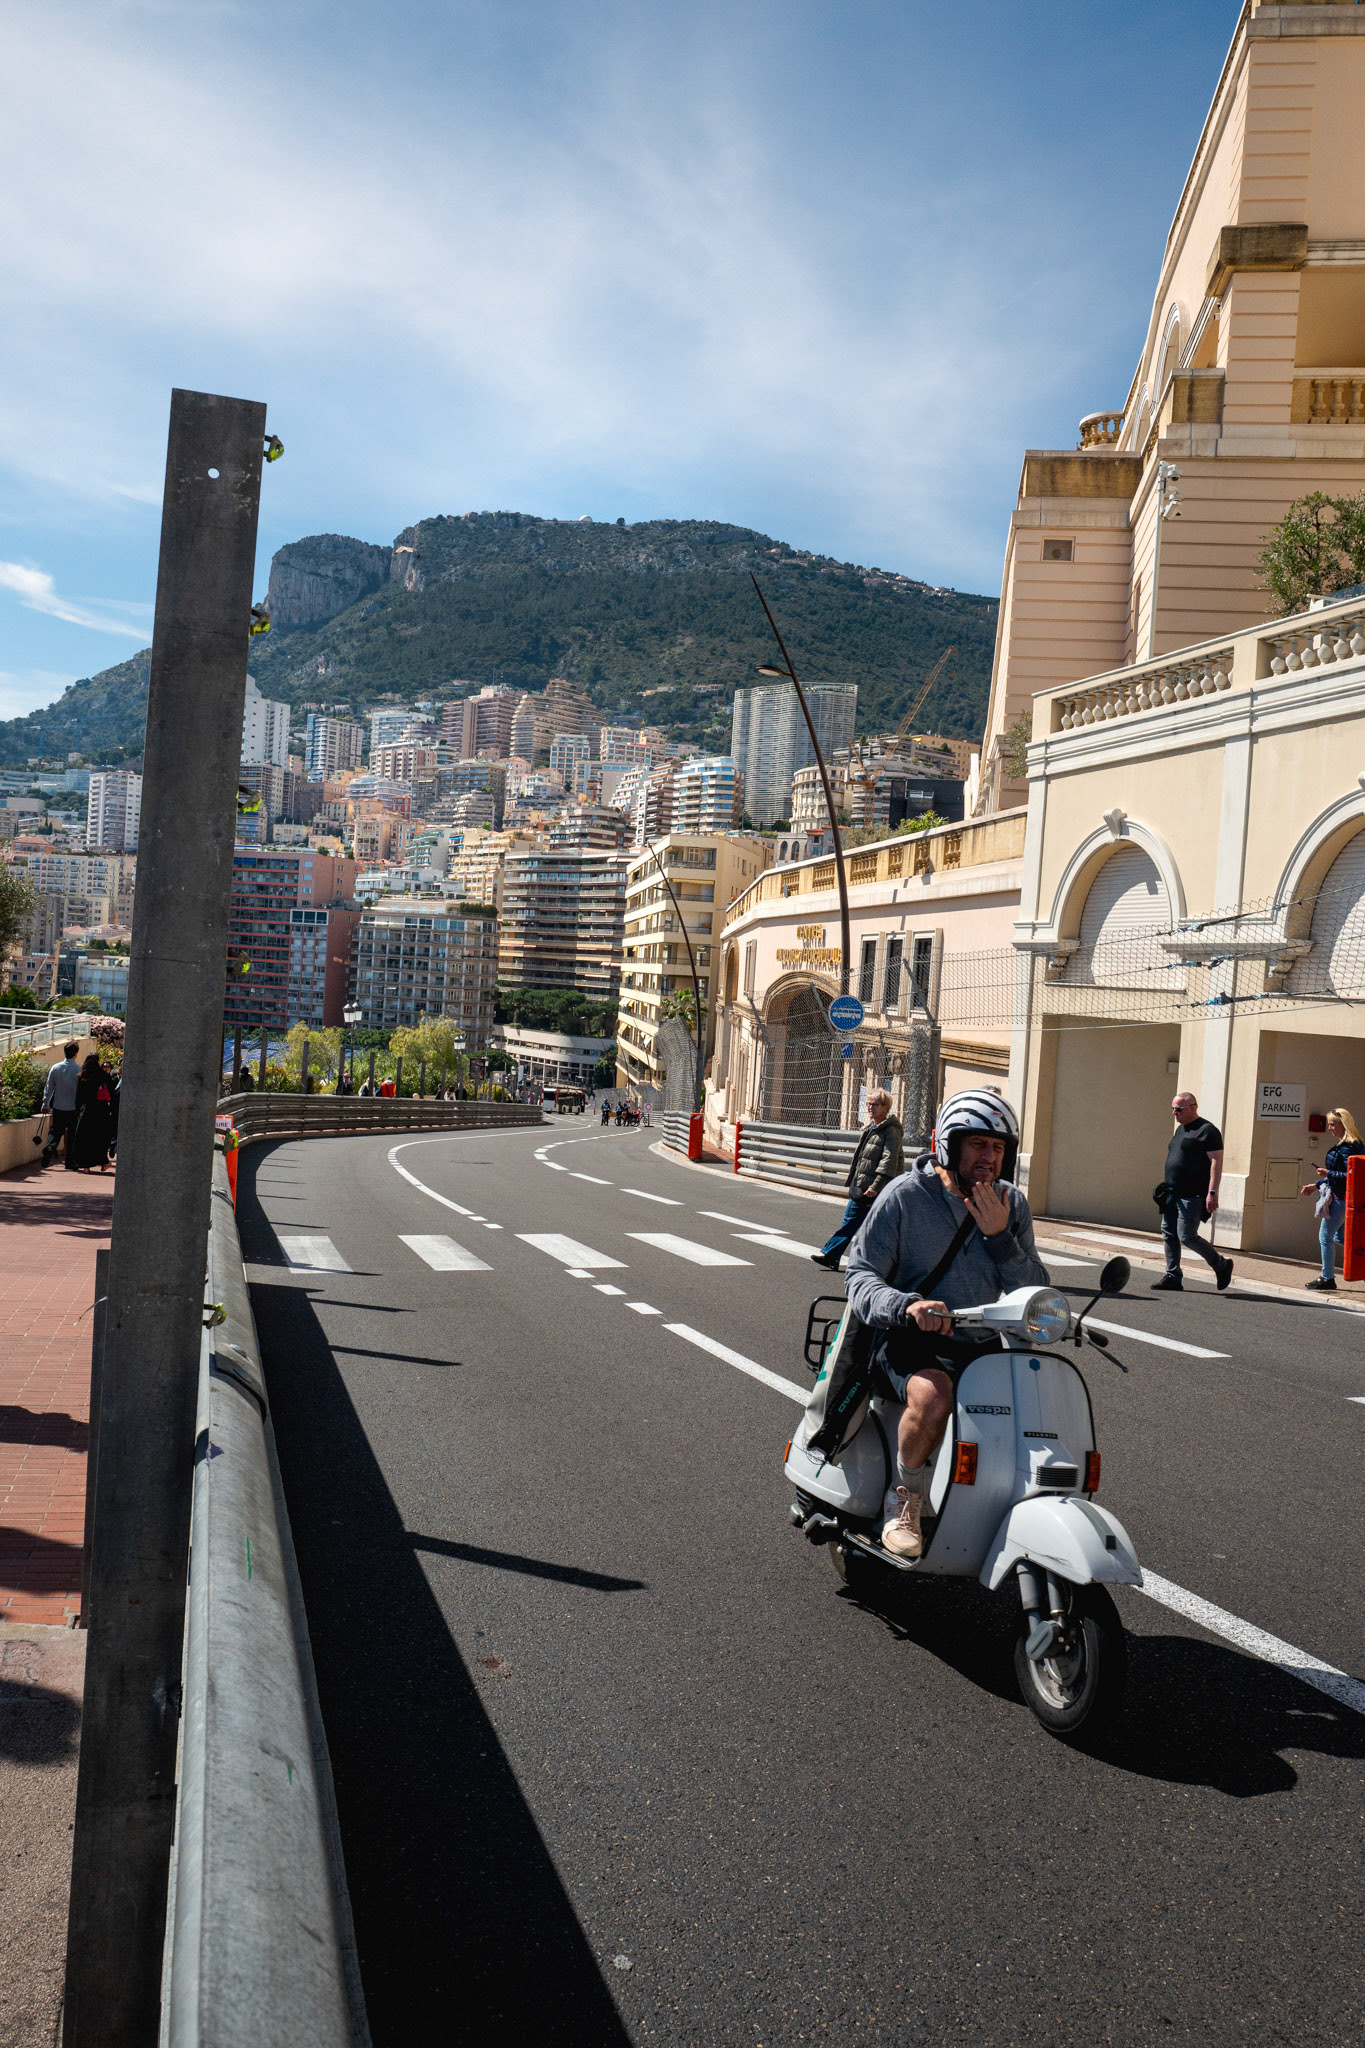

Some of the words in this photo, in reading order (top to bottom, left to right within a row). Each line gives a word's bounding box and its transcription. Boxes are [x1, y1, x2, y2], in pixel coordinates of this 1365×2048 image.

[1263, 1086, 1282, 1097] EFG
[1262, 1103, 1301, 1113] PARKING
[837, 1381, 861, 1414] HEAD
[967, 1405, 1011, 1415] vespa
